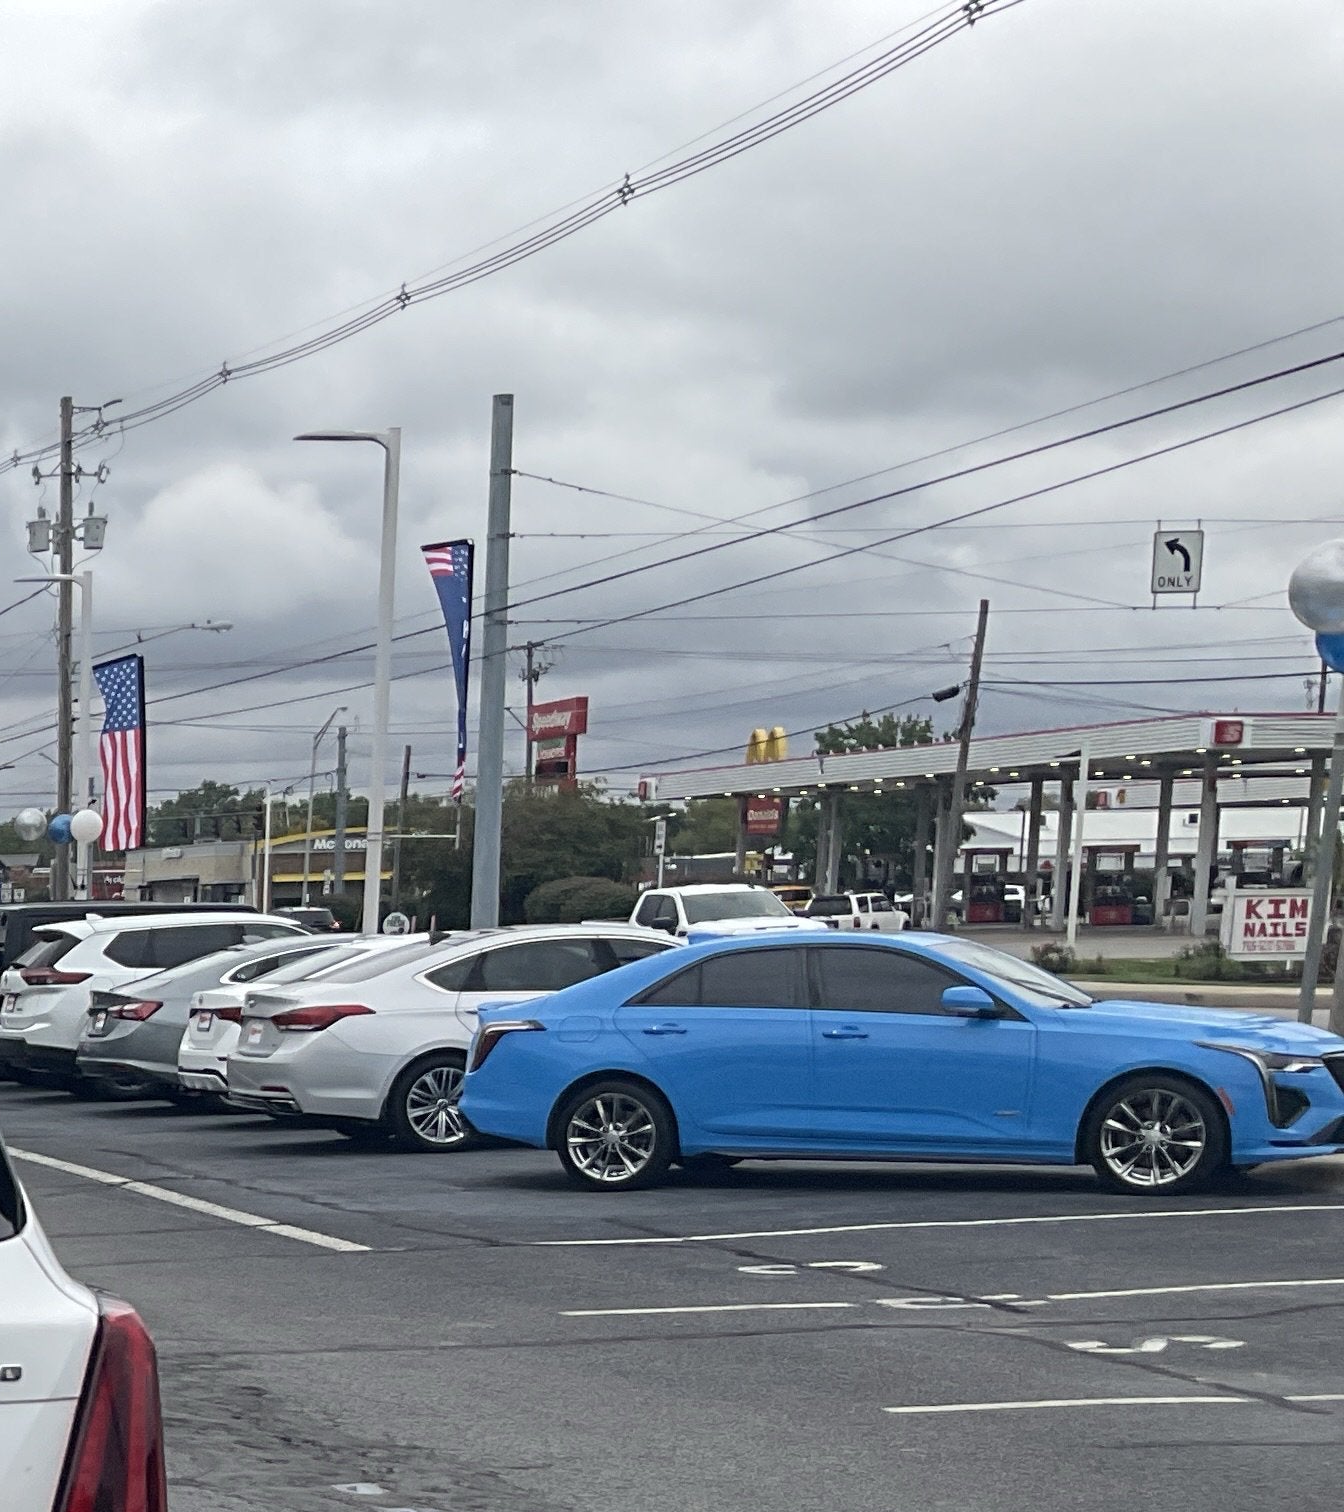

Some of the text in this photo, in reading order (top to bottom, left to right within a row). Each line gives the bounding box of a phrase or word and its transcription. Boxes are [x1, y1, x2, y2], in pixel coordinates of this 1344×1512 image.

[1157, 575, 1194, 588] ONLY
[1245, 898, 1309, 919] KIM
[1243, 922, 1307, 938] NAILS
